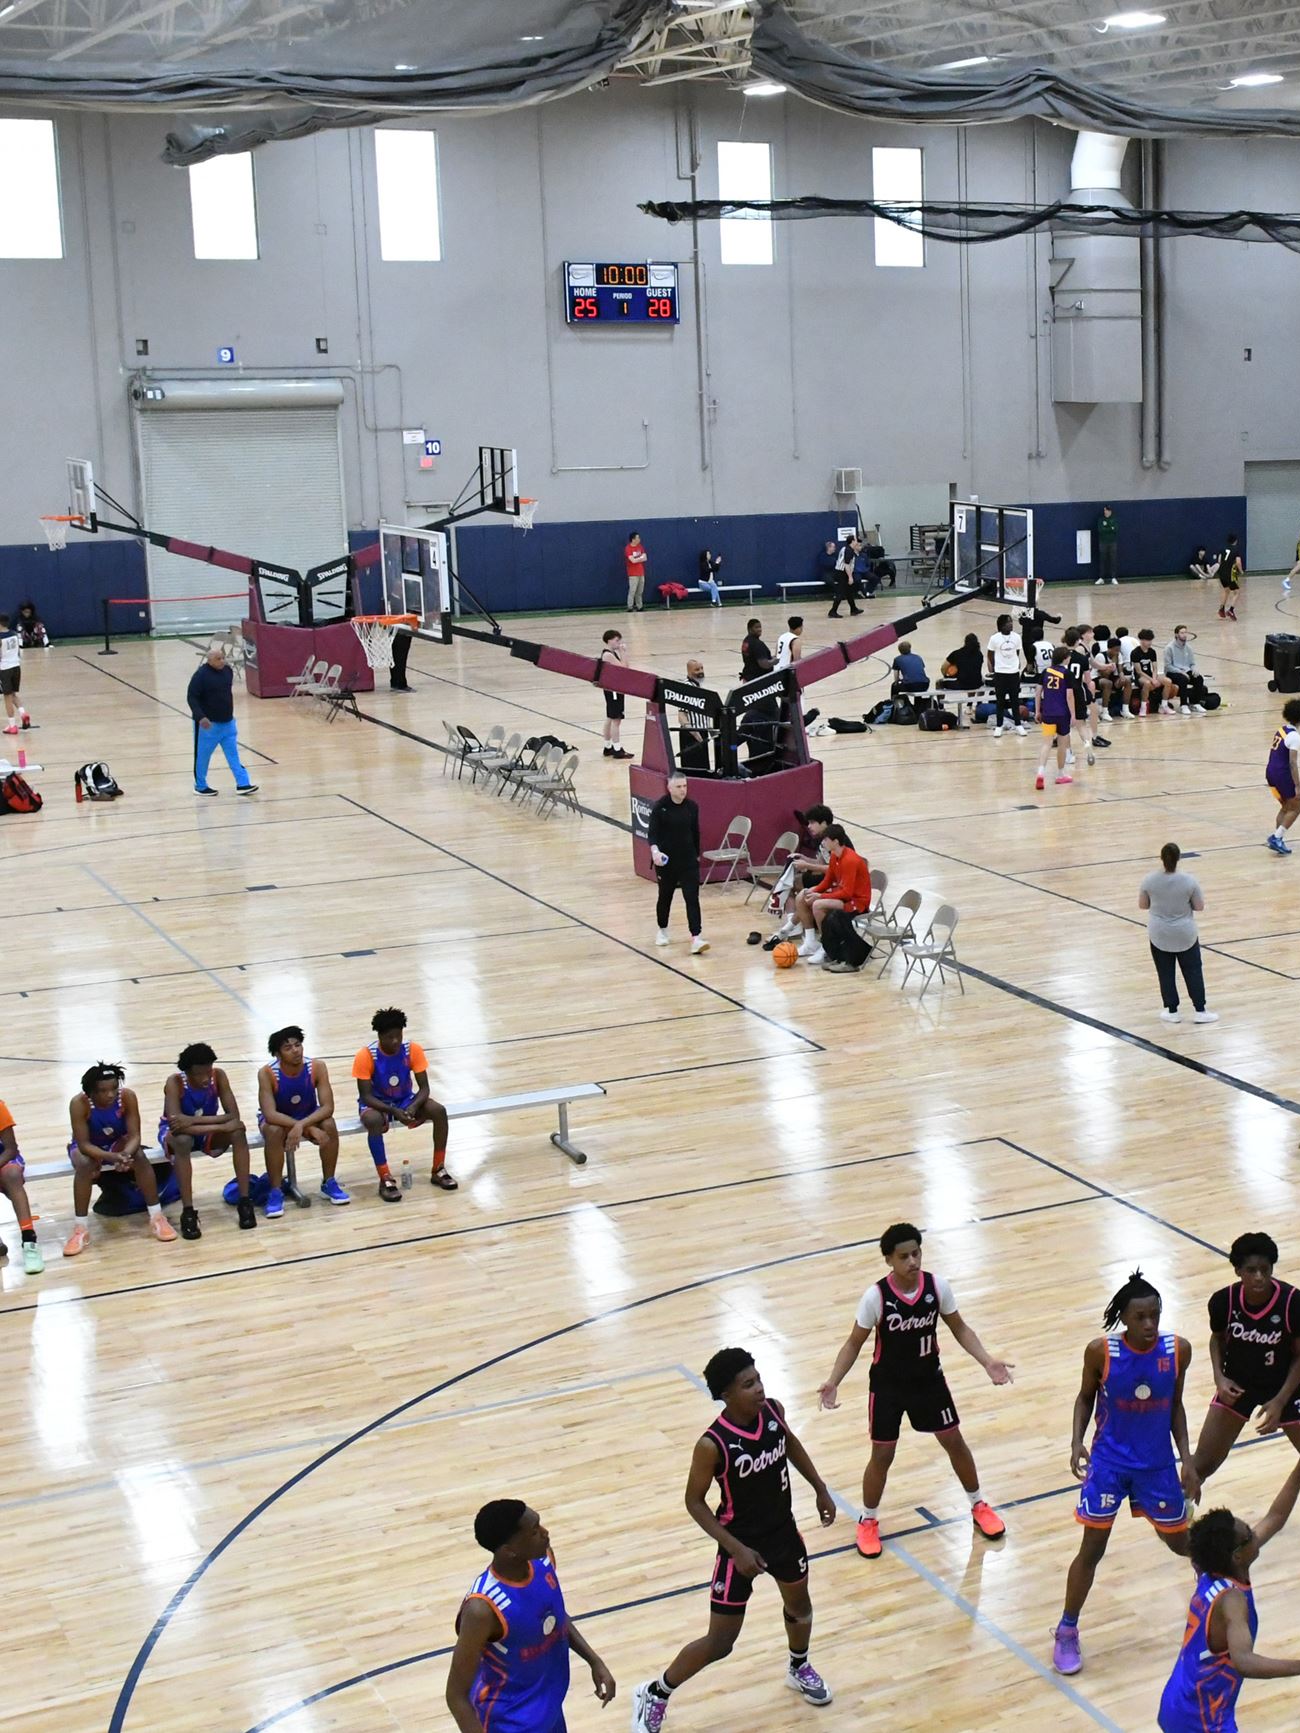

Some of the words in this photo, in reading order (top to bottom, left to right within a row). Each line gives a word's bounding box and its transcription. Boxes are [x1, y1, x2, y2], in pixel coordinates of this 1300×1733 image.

[603, 265, 646, 284] 10:00
[573, 288, 597, 297] HOME
[612, 292, 633, 300] PERIOD
[646, 288, 672, 298] GUEST
[574, 298, 597, 318] 25
[624, 302, 628, 314] 1
[648, 298, 671, 318] 28
[220, 348, 232, 362] 9
[425, 441, 440, 454] 10
[958, 515, 964, 530] 7
[431, 555, 437, 568] 4
[1224, 548, 1231, 561] 7
[258, 567, 291, 582] SPALDING
[316, 562, 349, 581] SPALDING
[1046, 675, 1060, 690] 23
[663, 688, 706, 710] SPALDING
[742, 680, 785, 707] SPALDING
[886, 1309, 937, 1332] Detroit
[1230, 1321, 1283, 1346] Detroit
[919, 1333, 933, 1358] 11
[1264, 1350, 1275, 1366] 3
[940, 1406, 954, 1426] 11
[734, 1434, 787, 1479] Detroit
[780, 1465, 789, 1492] 5
[1099, 1493, 1116, 1508] 15
[797, 1555, 807, 1574] 5
